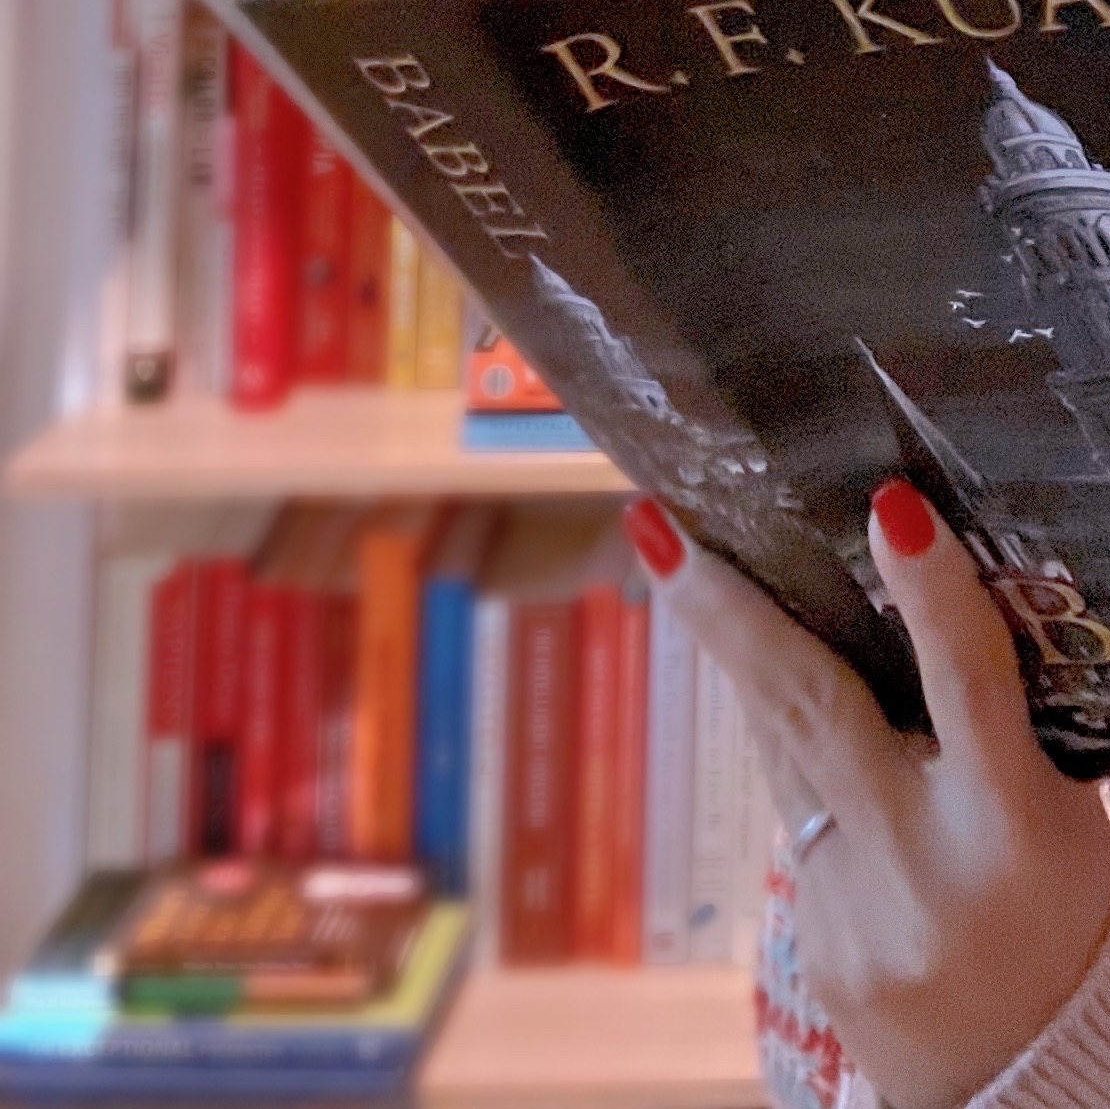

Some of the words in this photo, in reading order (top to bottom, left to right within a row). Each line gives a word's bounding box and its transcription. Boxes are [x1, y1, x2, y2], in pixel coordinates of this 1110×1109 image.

[146, 31, 172, 87] Viral
[540, 31, 691, 113] R.
[146, 91, 166, 121] BS
[352, 53, 549, 259] BABEL
[219, 583, 240, 655] Homo
[533, 627, 553, 654] THE
[160, 593, 186, 726] SAPIENS
[217, 662, 238, 724] Deus
[529, 657, 551, 751] INTELLIGENT
[527, 756, 549, 829] INVESTOR
[58, 1040, 194, 1058] EXCEPTIONAL
